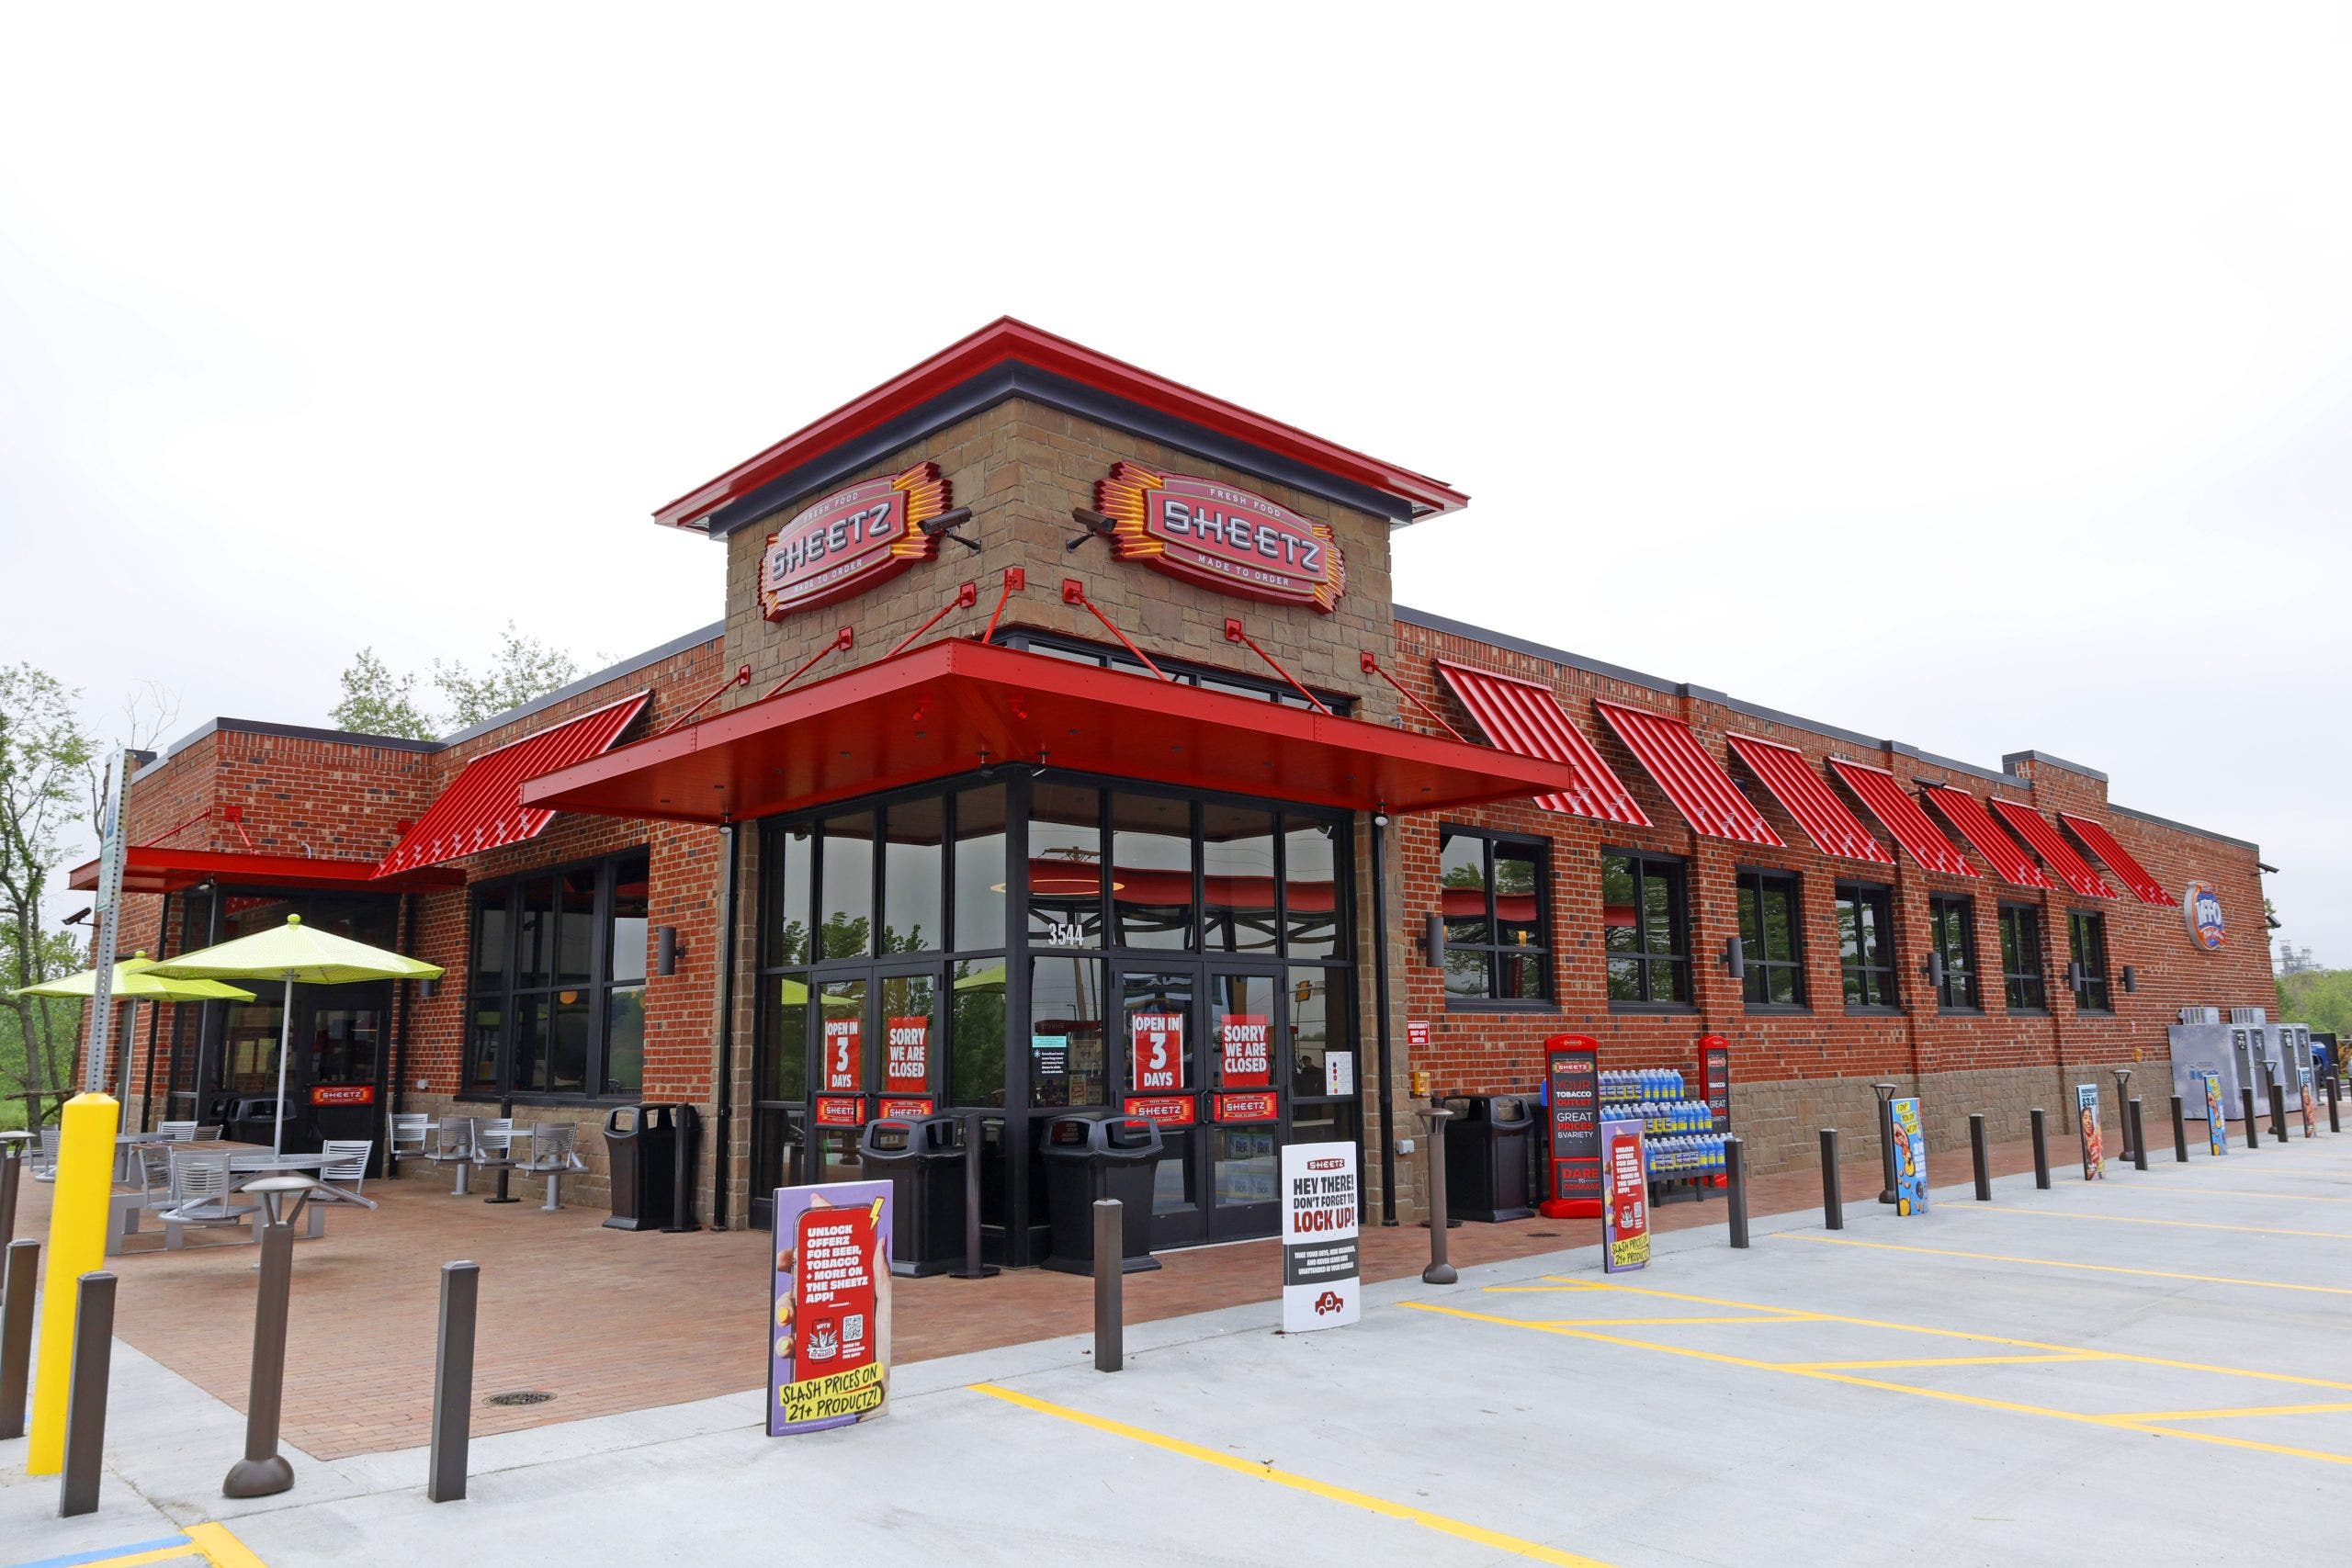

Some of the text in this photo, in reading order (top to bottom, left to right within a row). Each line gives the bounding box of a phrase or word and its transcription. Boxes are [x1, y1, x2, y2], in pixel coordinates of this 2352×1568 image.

[803, 492, 858, 524] FRESH FOOD
[1210, 489, 1281, 516] FRESH FOOD
[772, 502, 891, 581] SHEETZ
[1163, 500, 1319, 573] SHEETZ
[794, 559, 862, 592] MADE TO ORDER
[1198, 555, 1289, 586] MADE TO ORDER
[1048, 923, 1083, 946] 3544
[828, 1021, 857, 1035] OPEN IN
[1136, 1017, 1180, 1031] OPEN IN
[889, 1028, 925, 1045] SORRY
[1224, 1025, 1266, 1042] SORRY
[837, 1037, 848, 1071] 3
[890, 1046, 924, 1060] WE ARE
[1149, 1033, 1167, 1070] 3
[1226, 1043, 1266, 1056] WE ARE
[889, 1062, 924, 1077] CLOSED
[1225, 1058, 1266, 1073] CLOSED
[832, 1075, 852, 1088] DAYS
[1144, 1073, 1172, 1086] DAYS
[1556, 1080, 1590, 1089] YOUR
[1139, 1106, 1181, 1115] SHEETZ
[1227, 1102, 1264, 1111] SHEETZ
[1557, 1112, 1592, 1122] GREAT
[1310, 1159, 1344, 1168] SHEETZ
[1563, 1168, 1599, 1178] DARE
[1294, 1174, 1354, 1195] HEY THERE!
[1294, 1193, 1354, 1209] DON'T FORGET TO
[1294, 1206, 1354, 1233] LOCK UP!
[808, 1224, 853, 1236] UNLOCK
[807, 1235, 850, 1247] OFFERZ
[1612, 1241, 1628, 1255] SLASH
[807, 1246, 862, 1259] FOR BEER,
[807, 1257, 859, 1269] TOBACCO
[814, 1269, 847, 1280] MORE
[849, 1267, 863, 1277] ON
[806, 1277, 868, 1292] THE SHEETZ
[806, 1292, 834, 1303] APP!
[783, 1365, 876, 1404] SLASH PRICES ON
[789, 1387, 876, 1421] 21+ PRODUCTZ!
